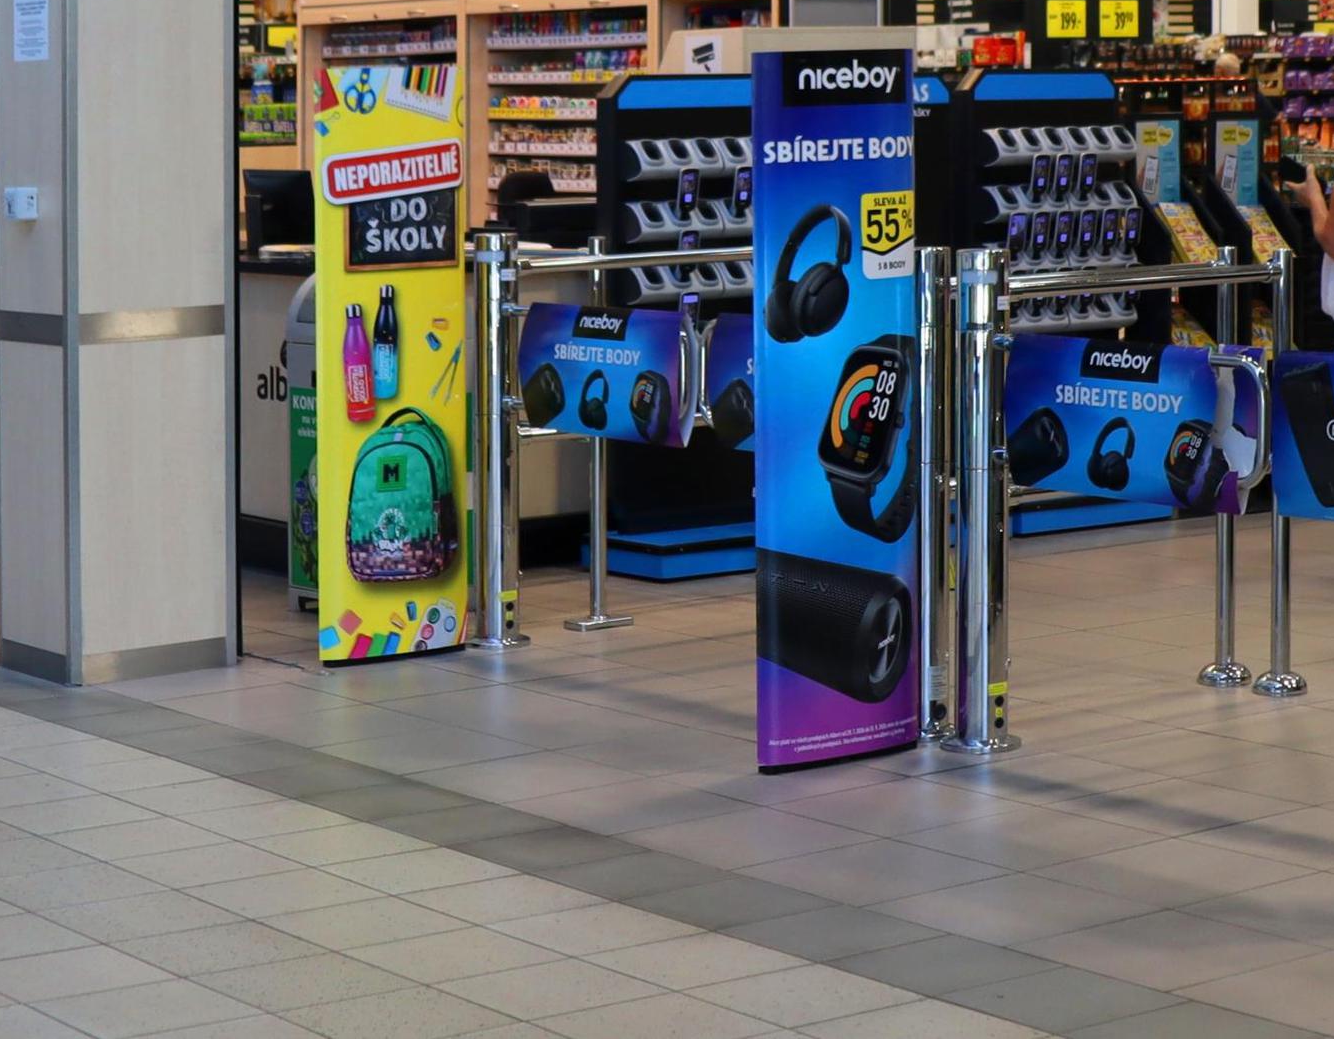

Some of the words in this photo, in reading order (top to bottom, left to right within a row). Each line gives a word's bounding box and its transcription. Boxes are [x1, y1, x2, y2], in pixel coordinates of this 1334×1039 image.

[798, 59, 896, 93] niceboy
[763, 136, 864, 164] SBÍREJTE
[868, 136, 914, 160] BODY
[333, 145, 458, 192] NEPORAZITELNÉ
[390, 197, 427, 222] DO
[873, 196, 896, 206] SLEVA
[898, 194, 907, 205] AŽ
[366, 217, 446, 253] ŠKOLY
[888, 261, 906, 270] BODY
[579, 314, 624, 332] niceboy
[554, 342, 604, 362] SBÍREJTE
[605, 349, 641, 366] BODY
[1090, 349, 1152, 374] niceboy
[257, 366, 288, 401] alb
[875, 370, 897, 395] 08
[868, 397, 890, 422] 30
[1055, 382, 1128, 410] SBÍREJTE
[1132, 391, 1183, 414] BODY
[1185, 446, 1198, 460] 30
[1190, 435, 1202, 448] 08
[383, 464, 399, 483] M
